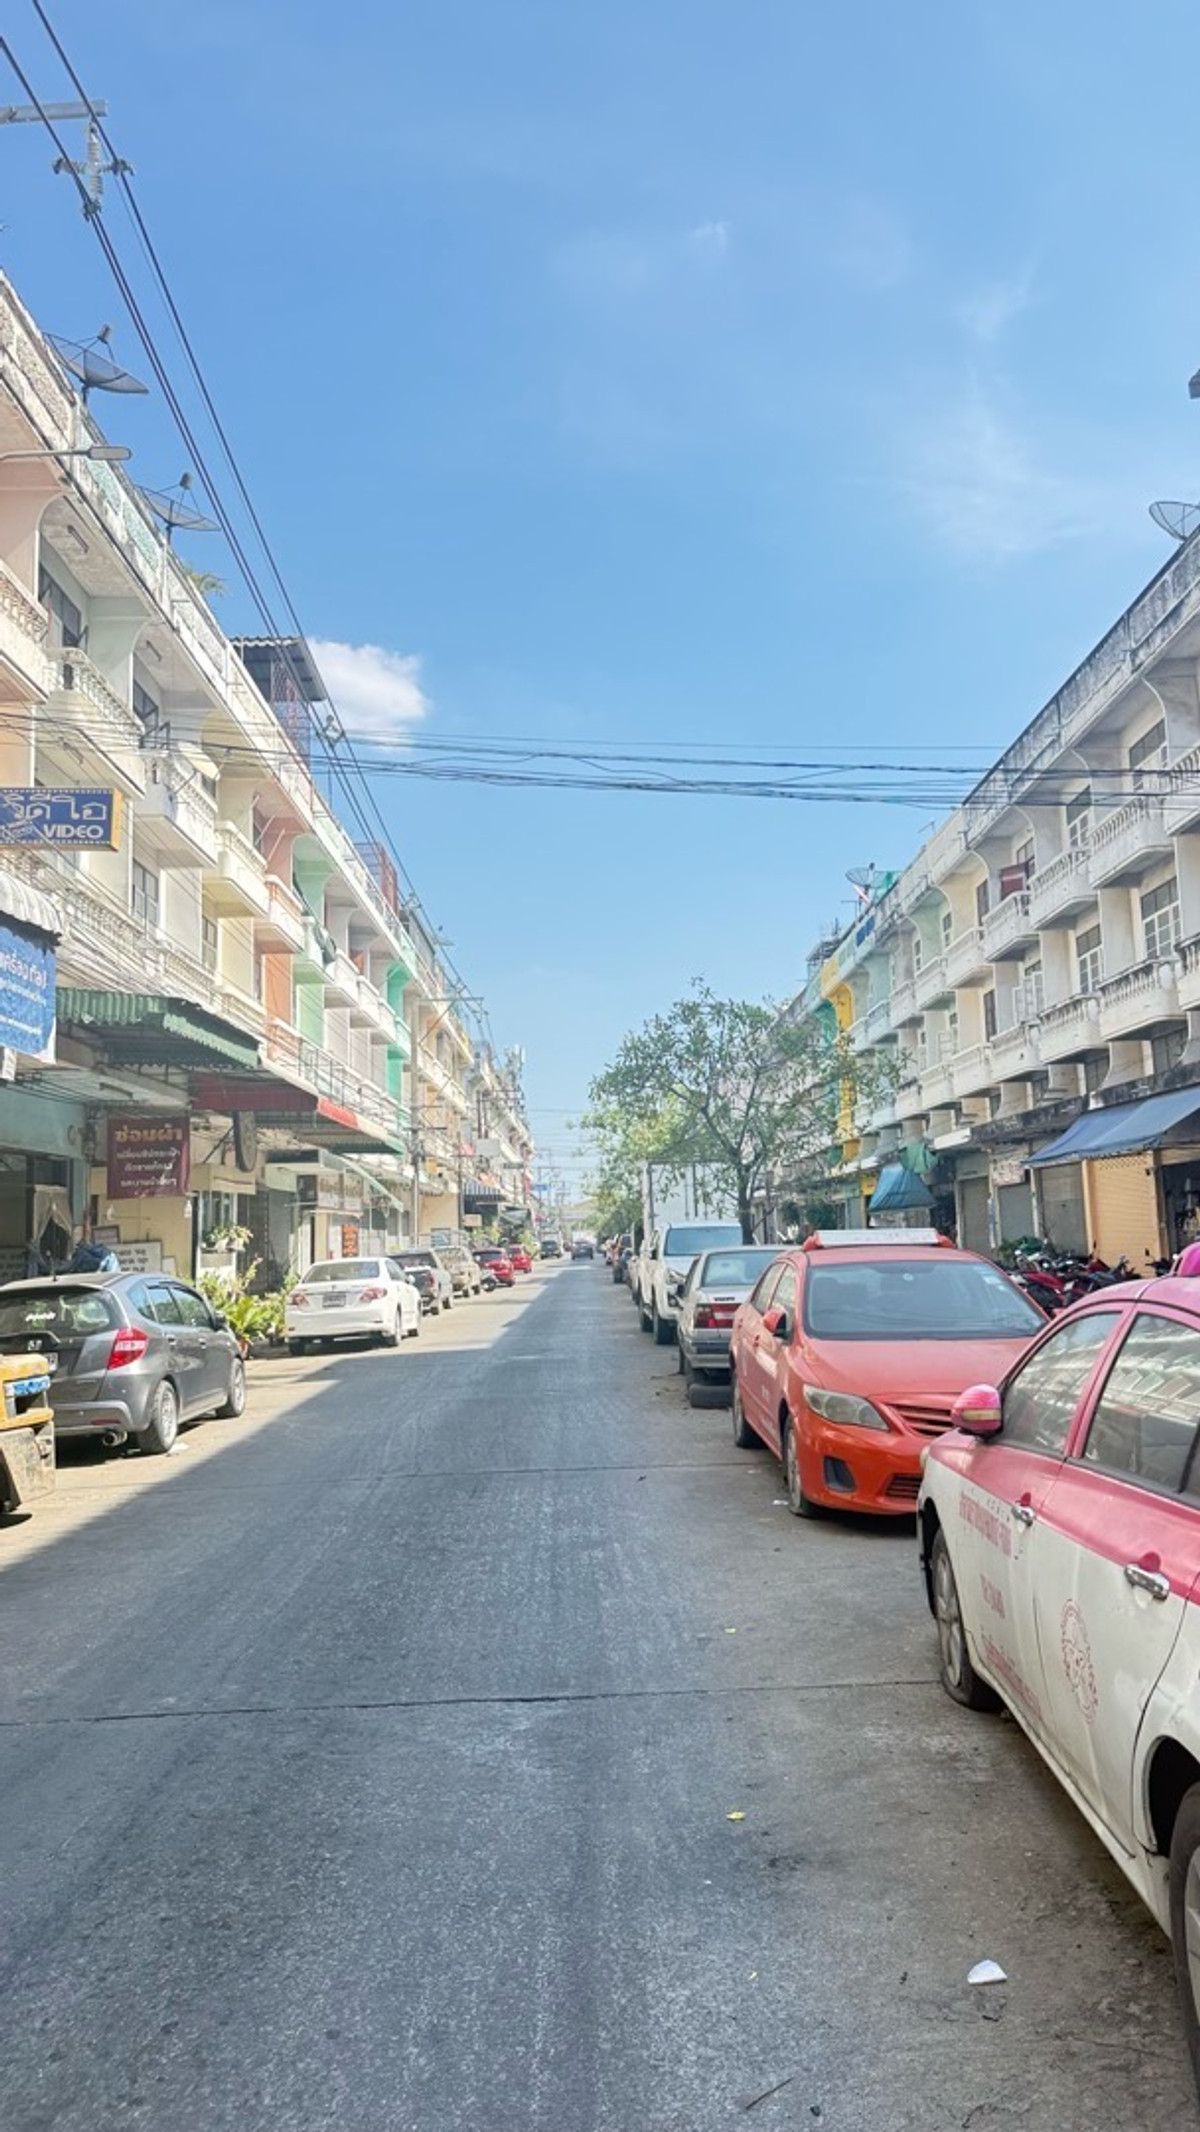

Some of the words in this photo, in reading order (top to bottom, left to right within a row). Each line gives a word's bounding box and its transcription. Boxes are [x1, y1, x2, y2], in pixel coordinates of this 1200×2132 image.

[43, 824, 104, 839] VIDEO
[115, 1123, 183, 1143] ซ่อมผ้า
